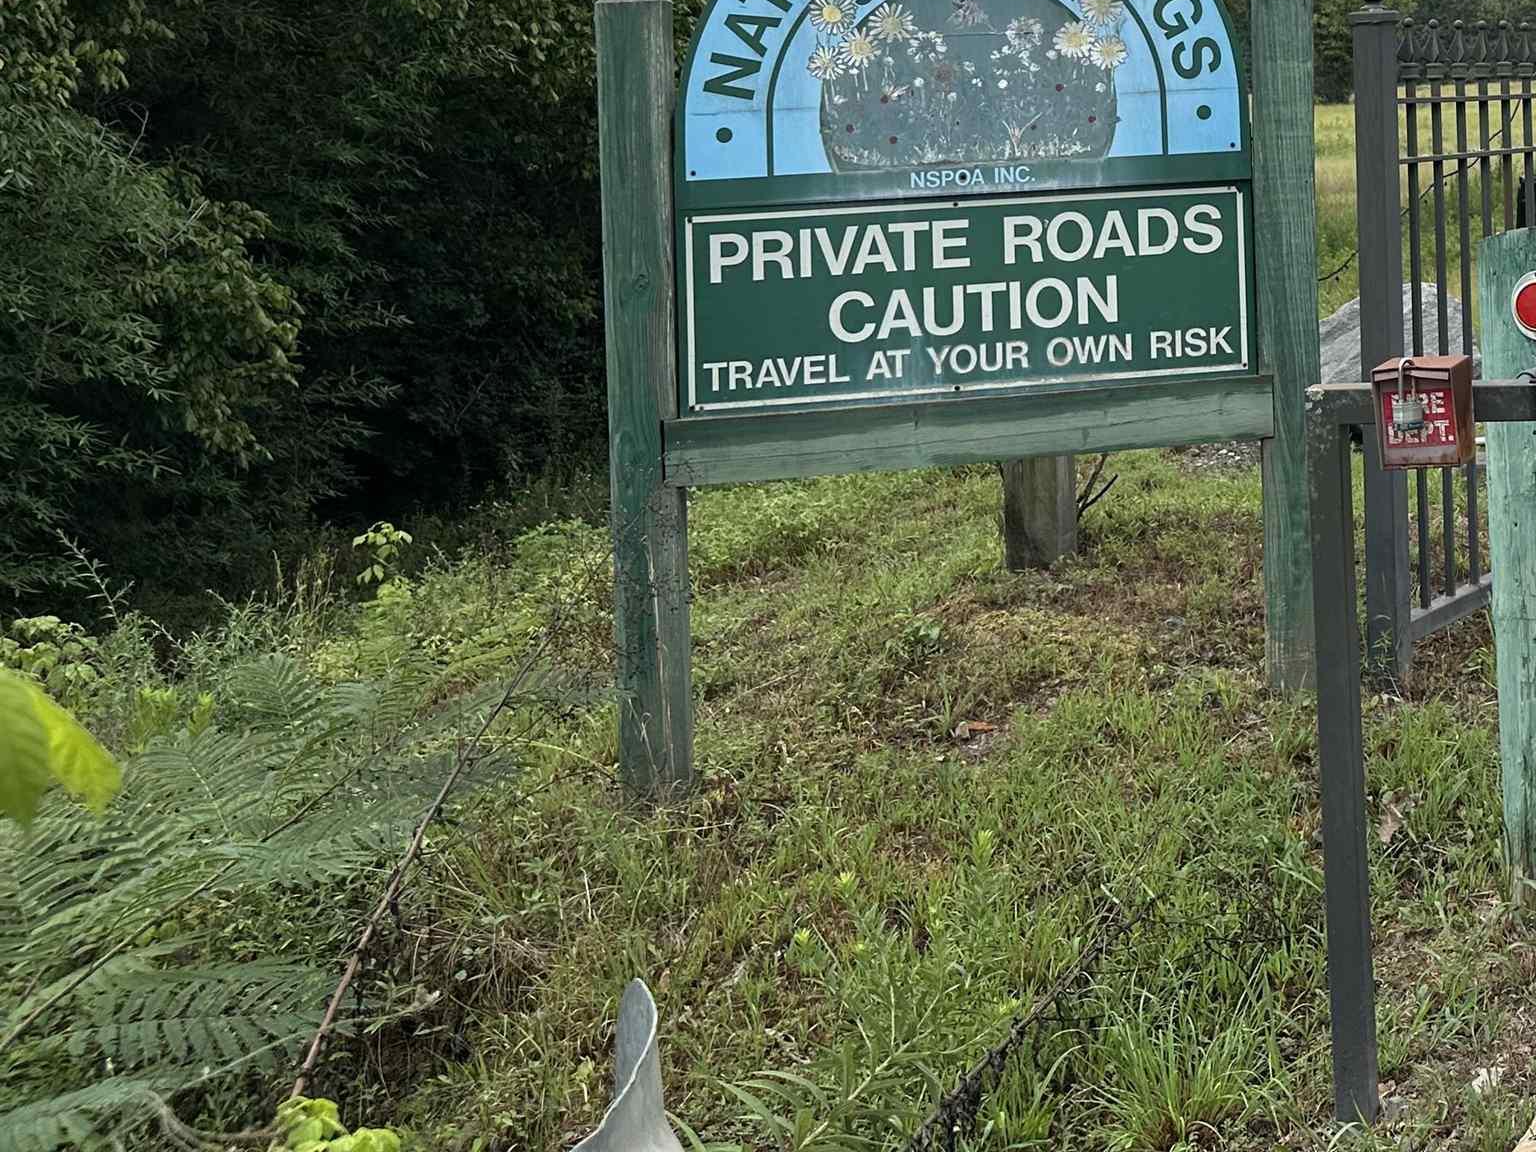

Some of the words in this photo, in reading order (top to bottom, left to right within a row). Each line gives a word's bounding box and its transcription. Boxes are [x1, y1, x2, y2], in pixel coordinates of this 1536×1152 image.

[909, 168, 985, 189] NSPOA
[993, 165, 1036, 185] INC.
[709, 219, 971, 284] PRIVATE
[1003, 204, 1223, 266] ROADS
[828, 275, 1119, 343] CAUTION
[703, 355, 850, 392] TRAVEL
[865, 349, 912, 381] AT
[926, 341, 1030, 376] YOUR
[1046, 333, 1133, 367] OWN
[1150, 326, 1234, 360] RISK
[1391, 392, 1446, 414] RE
